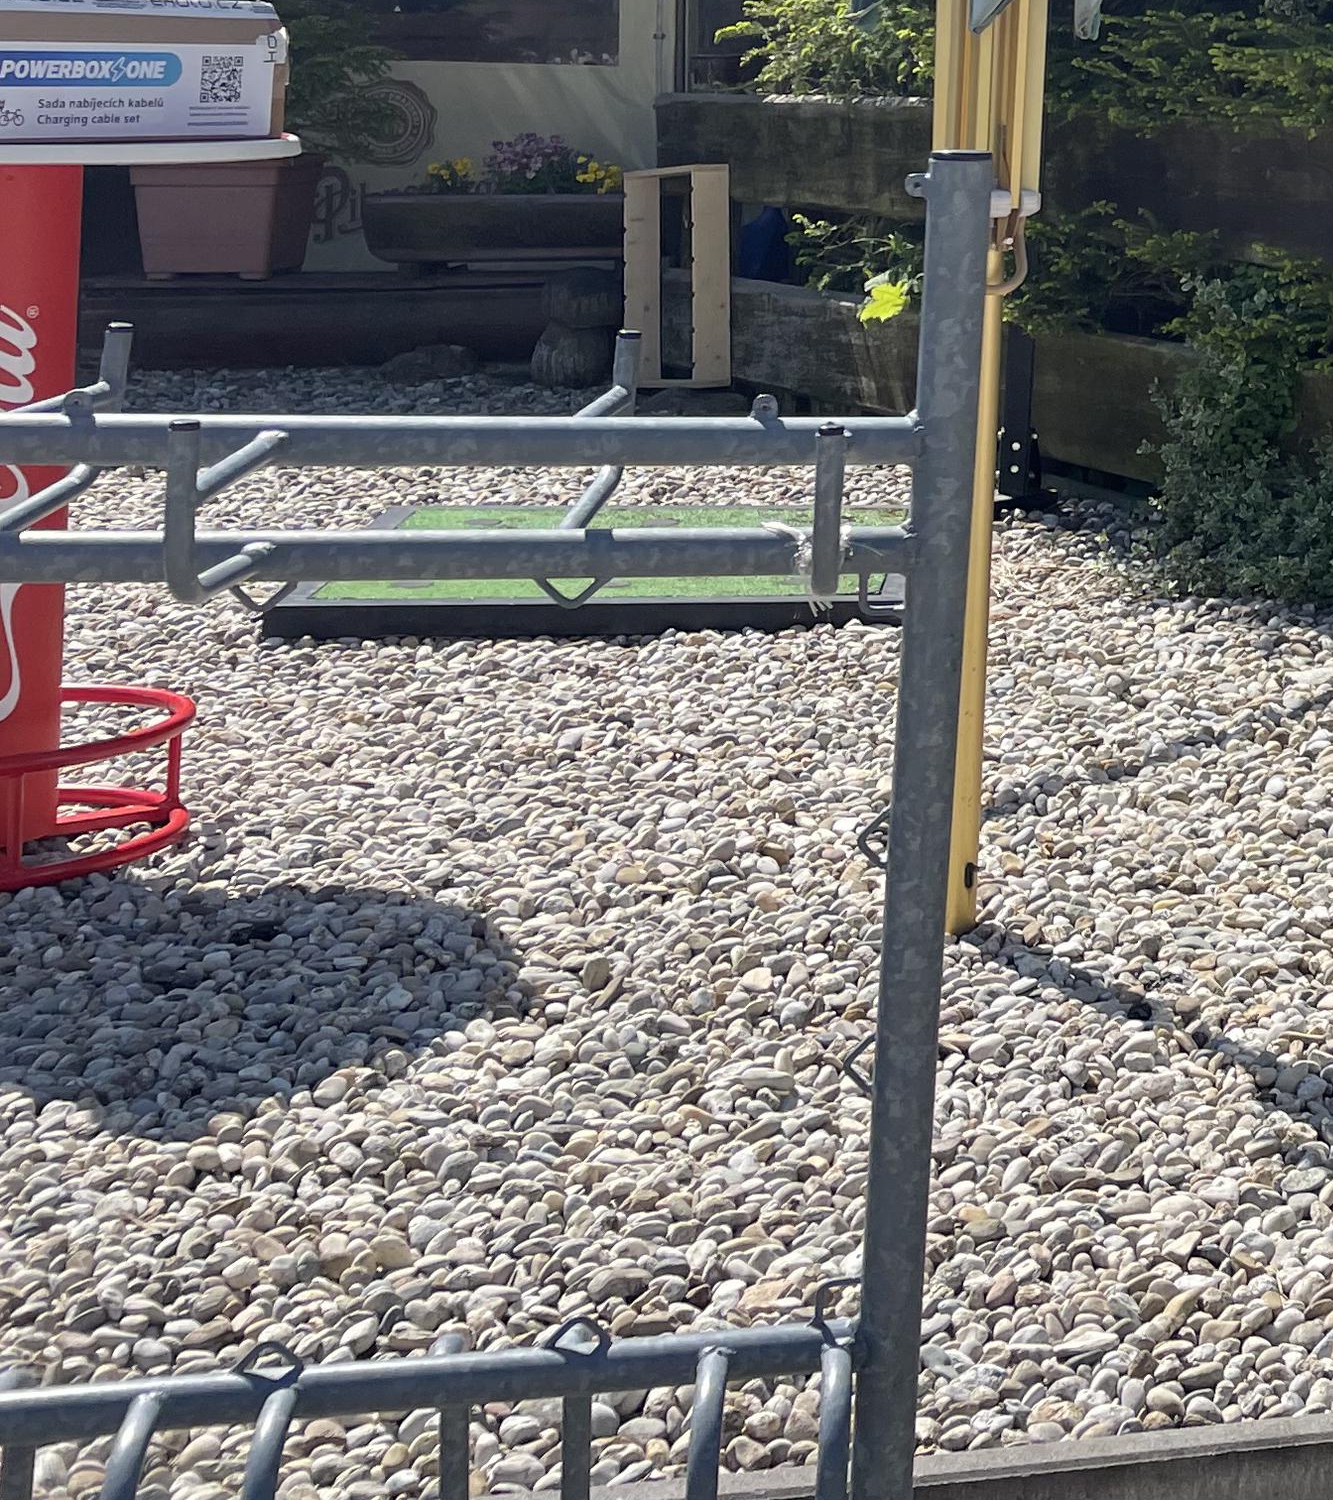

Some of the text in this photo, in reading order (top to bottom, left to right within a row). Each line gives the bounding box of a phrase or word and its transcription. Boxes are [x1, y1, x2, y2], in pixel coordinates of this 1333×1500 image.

[126, 61, 168, 79] ONE
[38, 99, 66, 109] Sada
[128, 98, 164, 109] kabelů
[37, 114, 140, 126] Charging cable set
